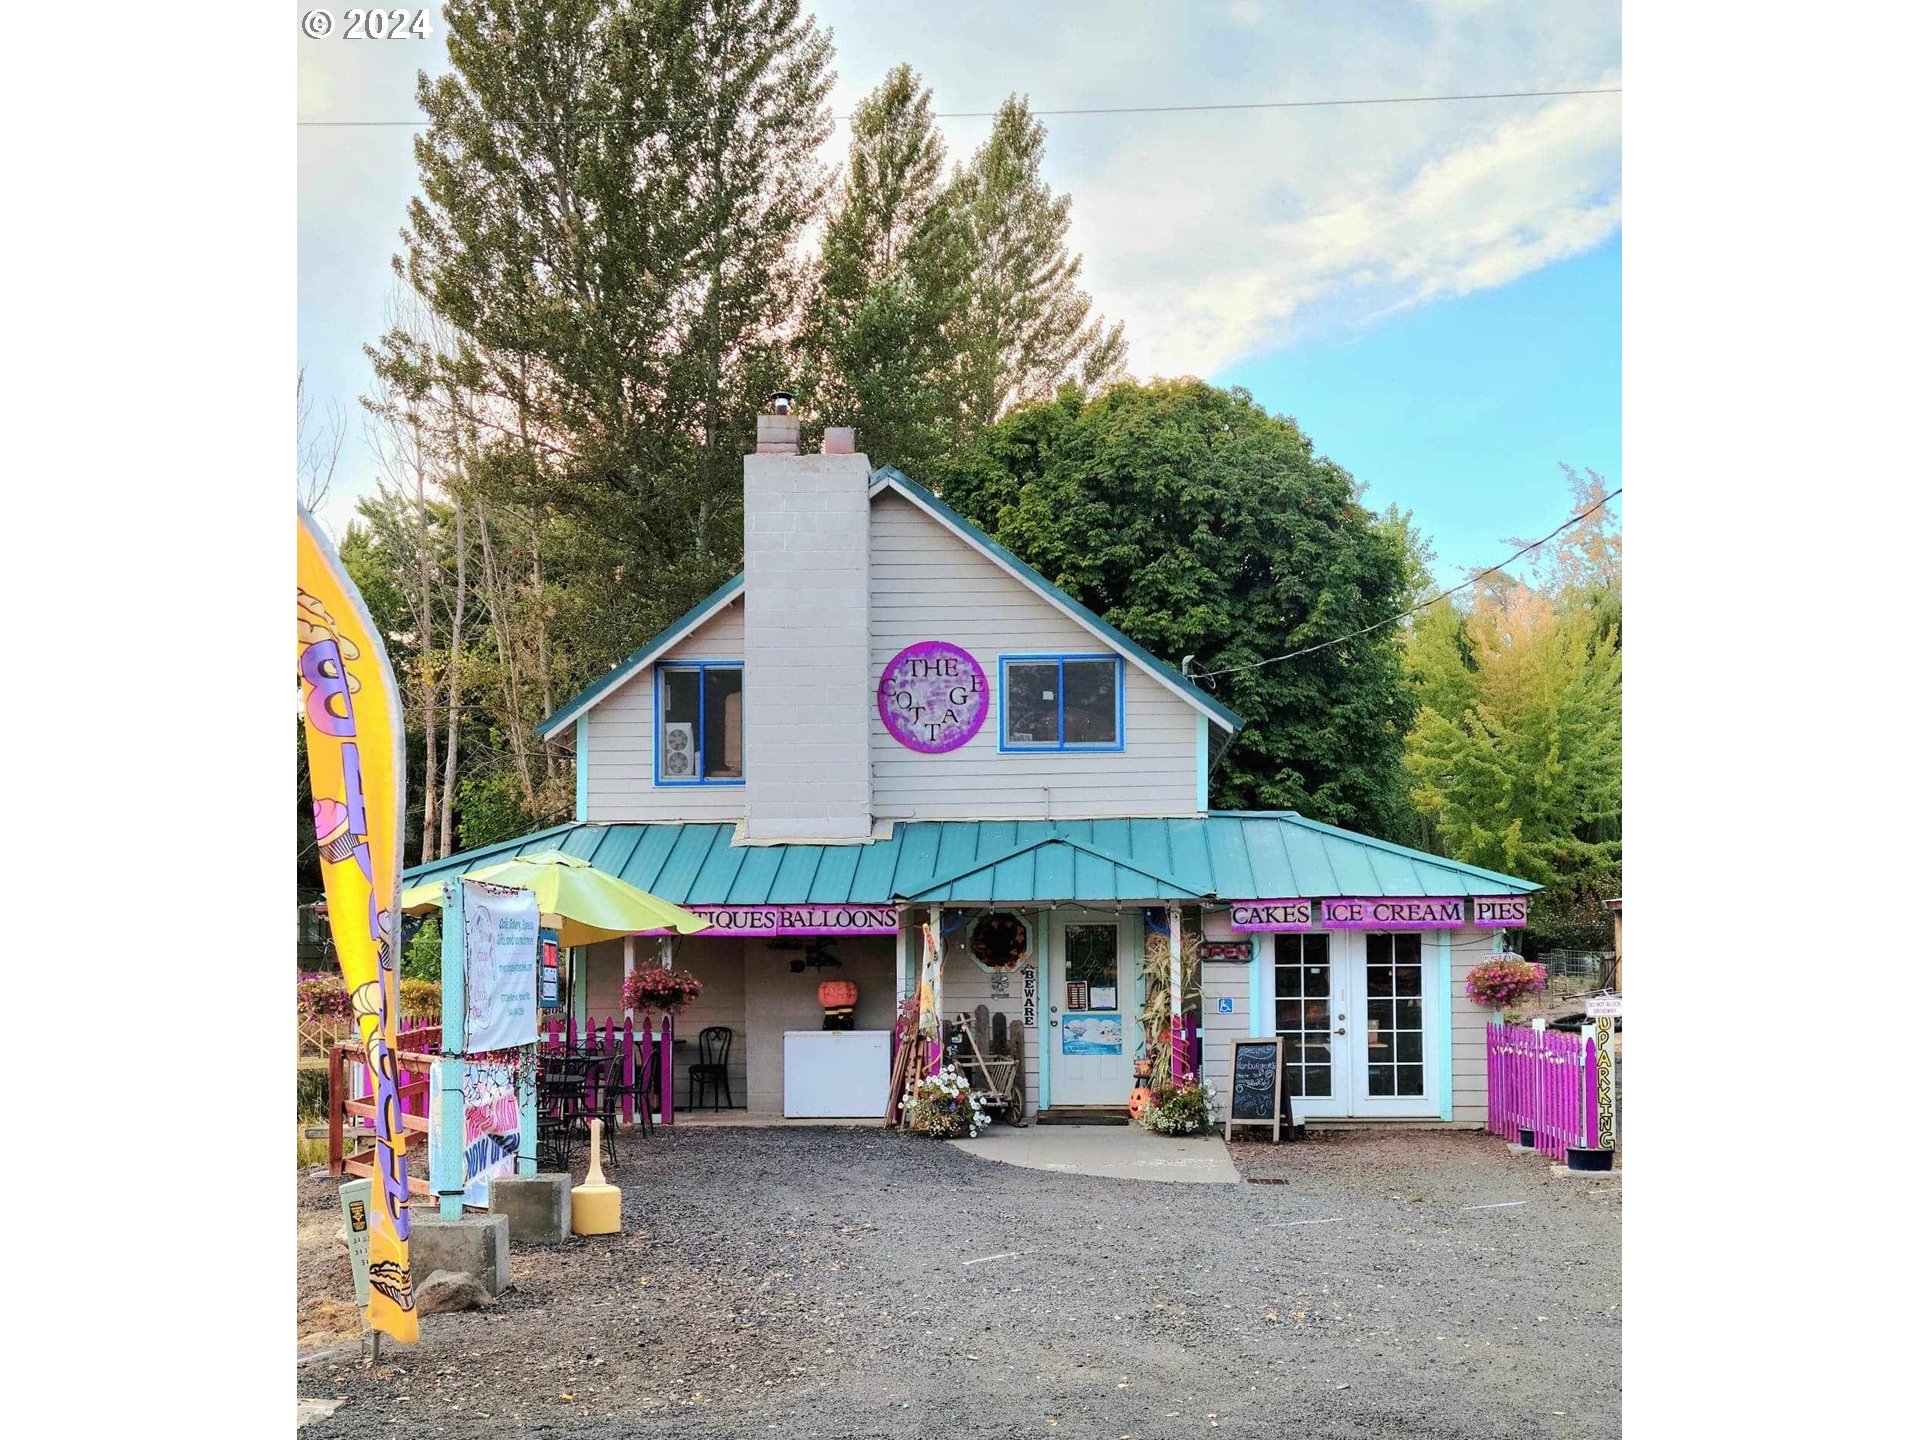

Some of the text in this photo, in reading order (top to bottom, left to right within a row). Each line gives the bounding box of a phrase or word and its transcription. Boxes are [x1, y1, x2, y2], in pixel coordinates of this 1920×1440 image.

[906, 658, 959, 677] THE
[881, 674, 985, 741] COTTAGE
[780, 909, 897, 928] BALLOONS
[1232, 905, 1310, 925] CAKES
[1326, 903, 1461, 921] ICE CREAM
[1477, 902, 1525, 920] PIES
[1024, 970, 1035, 1026] BEWARE
